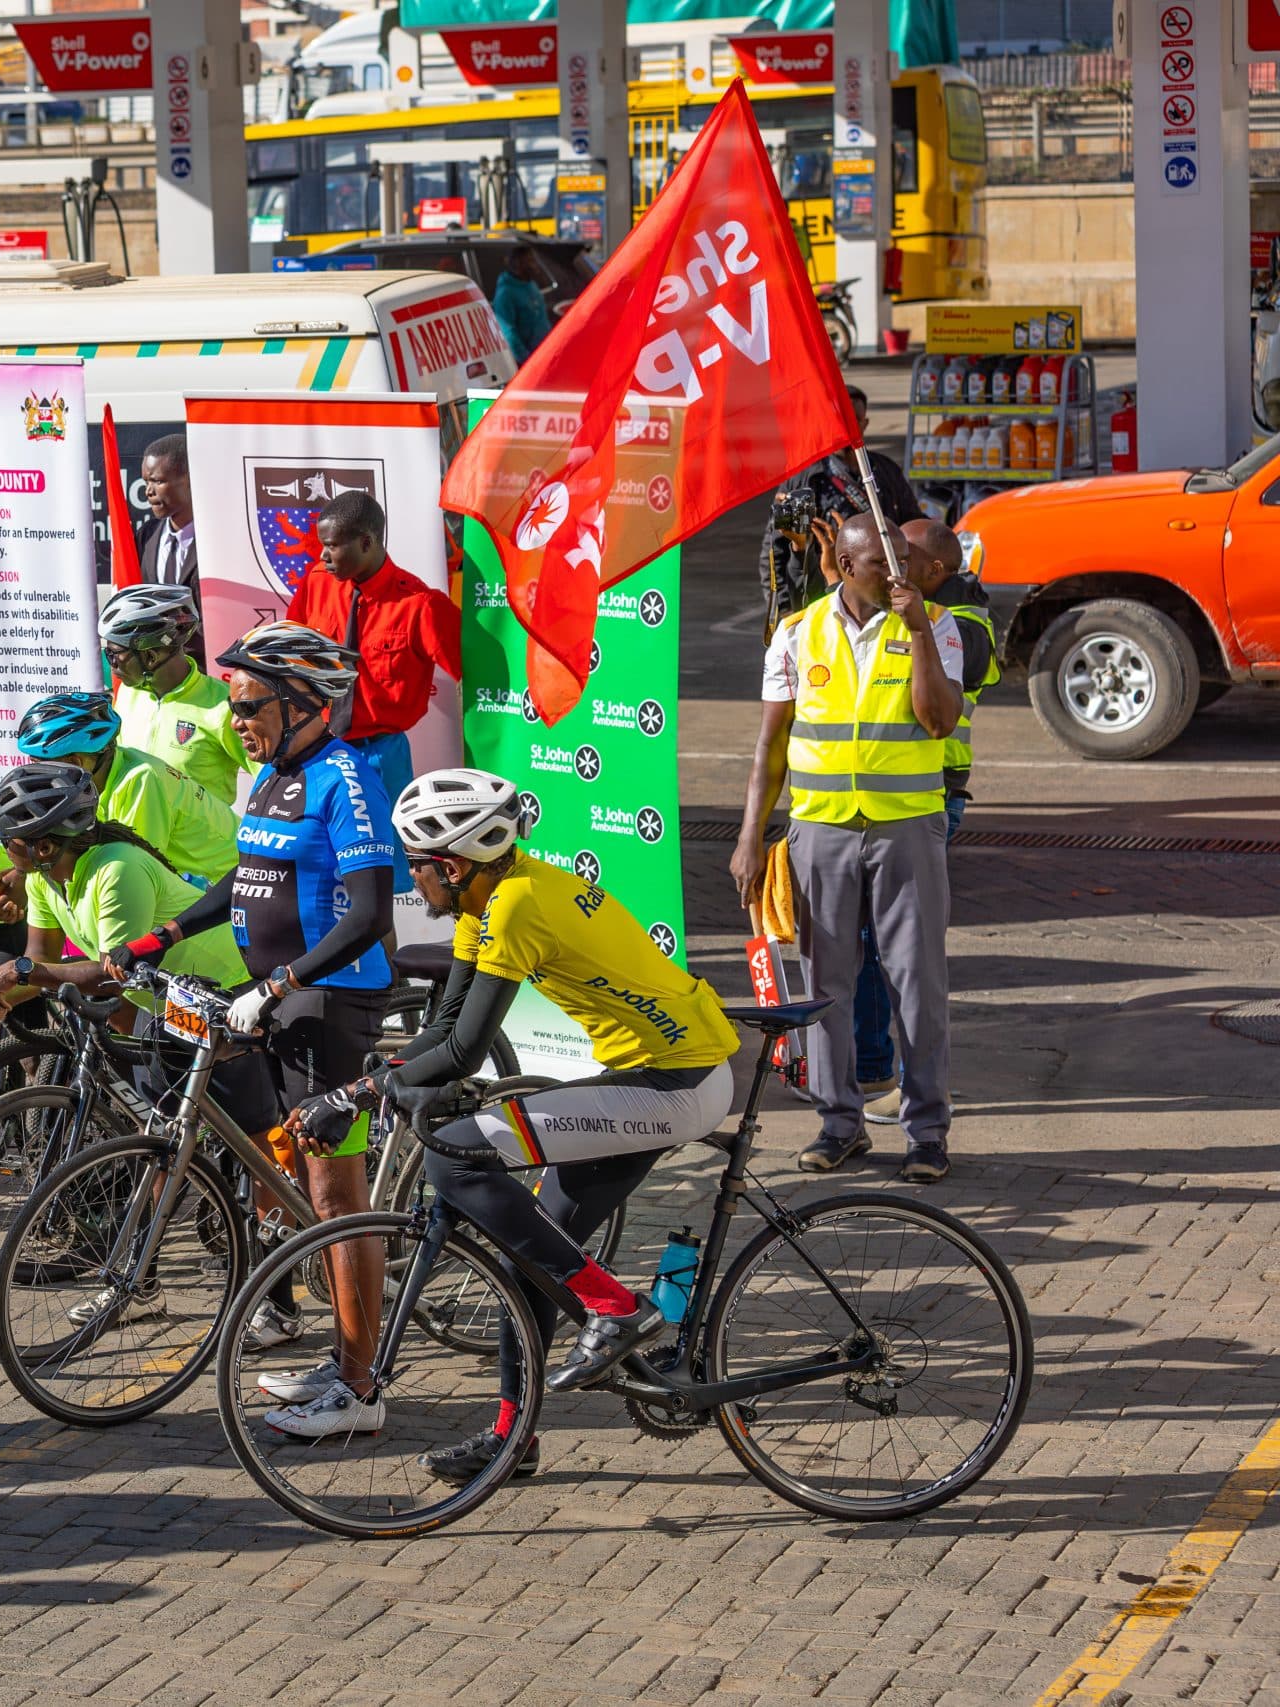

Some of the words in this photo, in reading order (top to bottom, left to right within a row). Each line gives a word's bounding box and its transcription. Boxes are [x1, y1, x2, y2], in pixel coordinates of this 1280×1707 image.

[51, 36, 85, 51] Shell
[52, 52, 142, 71] V-Power
[471, 54, 548, 71] V-Power
[544, 416, 577, 433] AID
[616, 419, 669, 441] ERTS
[0, 526, 11, 539] for
[12, 529, 23, 539] an
[24, 527, 76, 542] Empowered
[14, 590, 22, 602] of
[23, 590, 71, 603] vulnerable
[475, 582, 491, 597] St
[492, 582, 507, 598] Jo
[475, 598, 510, 608] Ambul
[608, 593, 638, 609] John
[11, 608, 31, 620] with
[32, 608, 80, 622] disabilities
[9, 626, 39, 641] elderly
[41, 627, 55, 639] for
[46, 645, 81, 661] through
[10, 663, 49, 675] inclusive
[51, 664, 68, 676] and
[476, 688, 493, 703] St
[495, 688, 522, 705] John
[477, 703, 522, 715] Ambulance
[592, 699, 608, 716] St
[610, 701, 636, 719] John
[592, 715, 636, 729] Ambulance
[530, 744, 543, 759] St
[545, 745, 573, 763] John
[530, 759, 573, 774] Ambulance
[339, 759, 375, 839] GIANT
[590, 805, 603, 821] St
[605, 806, 634, 825] John
[591, 820, 634, 836] Ambulance
[336, 843, 395, 862] POWERED
[544, 850, 572, 869] John
[574, 883, 606, 919] Rab
[759, 947, 774, 989] Shell
[751, 950, 767, 1007] V-Po
[584, 975, 690, 1047] Robank
[532, 1030, 594, 1046] www.stjohnken
[544, 1117, 617, 1134] PASSIONATE
[623, 1120, 672, 1135] CYCLING
